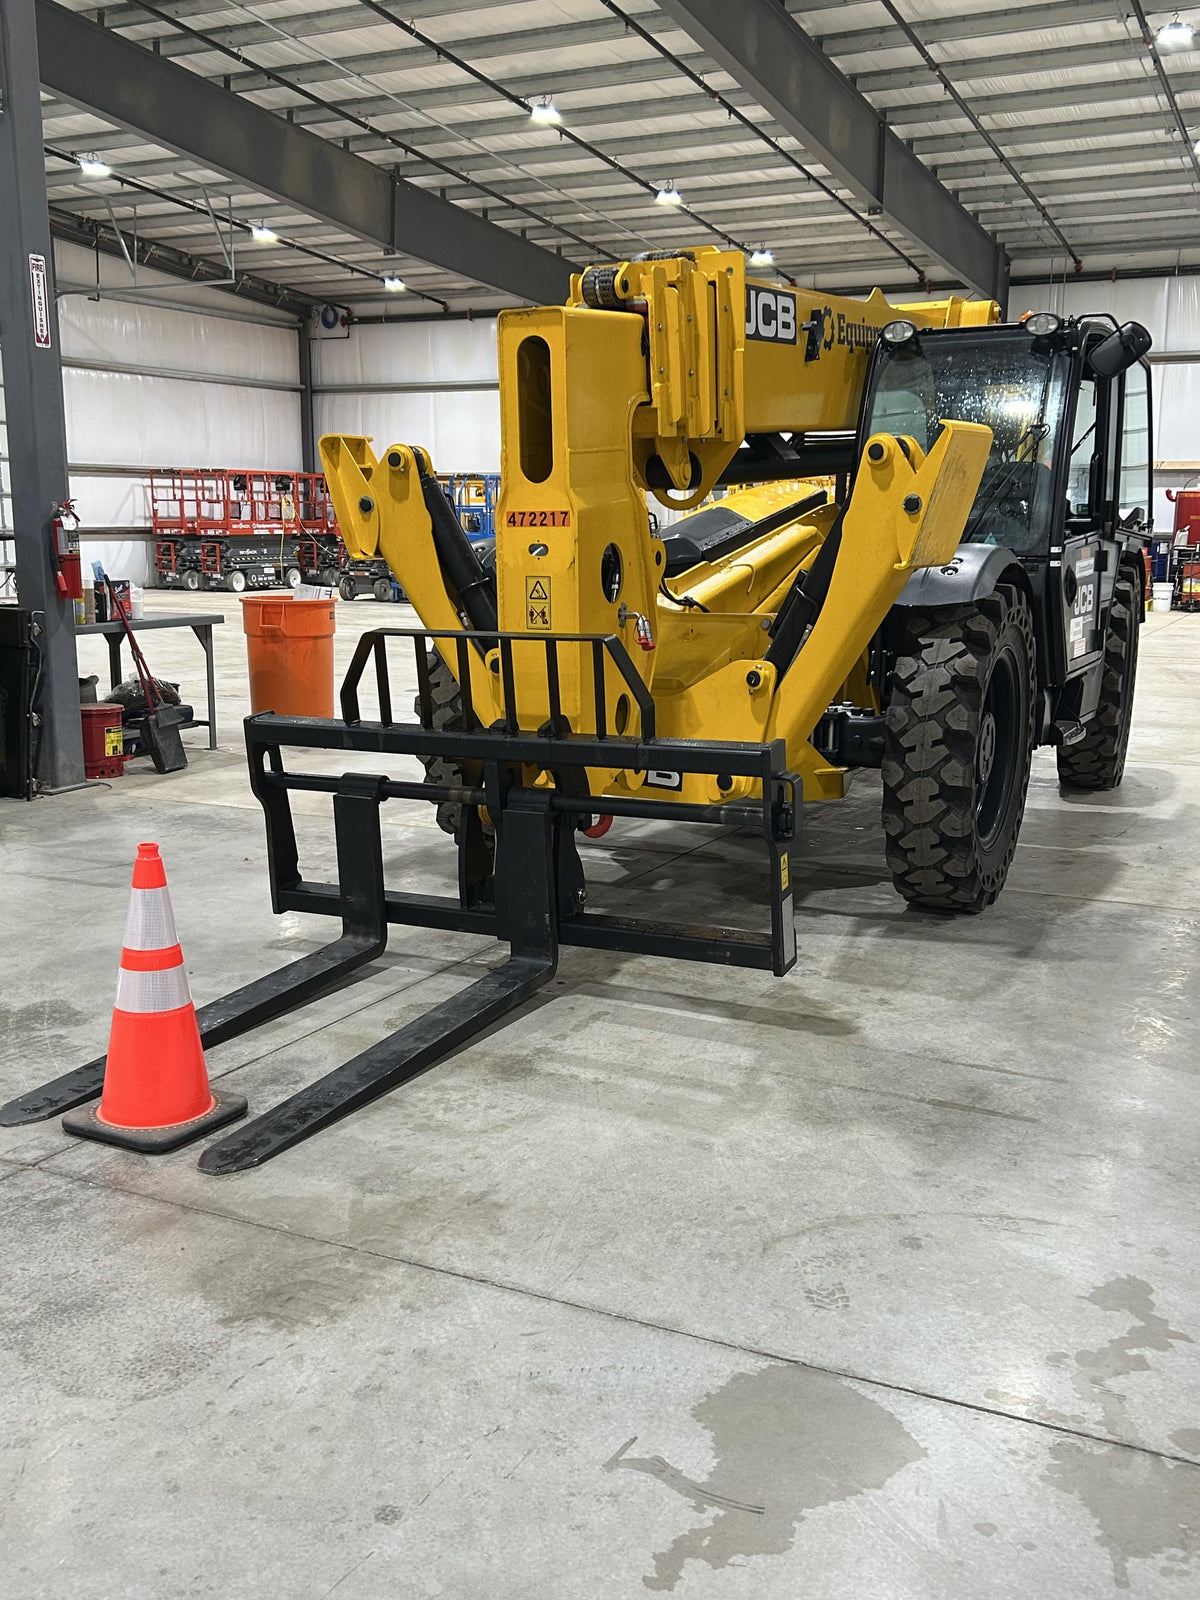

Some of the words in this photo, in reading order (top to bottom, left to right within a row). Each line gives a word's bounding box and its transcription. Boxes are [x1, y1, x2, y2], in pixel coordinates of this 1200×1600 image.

[31, 263, 43, 272] FIRE
[745, 289, 796, 340] JCB
[508, 511, 568, 526] 472217
[1074, 584, 1093, 615] JCB
